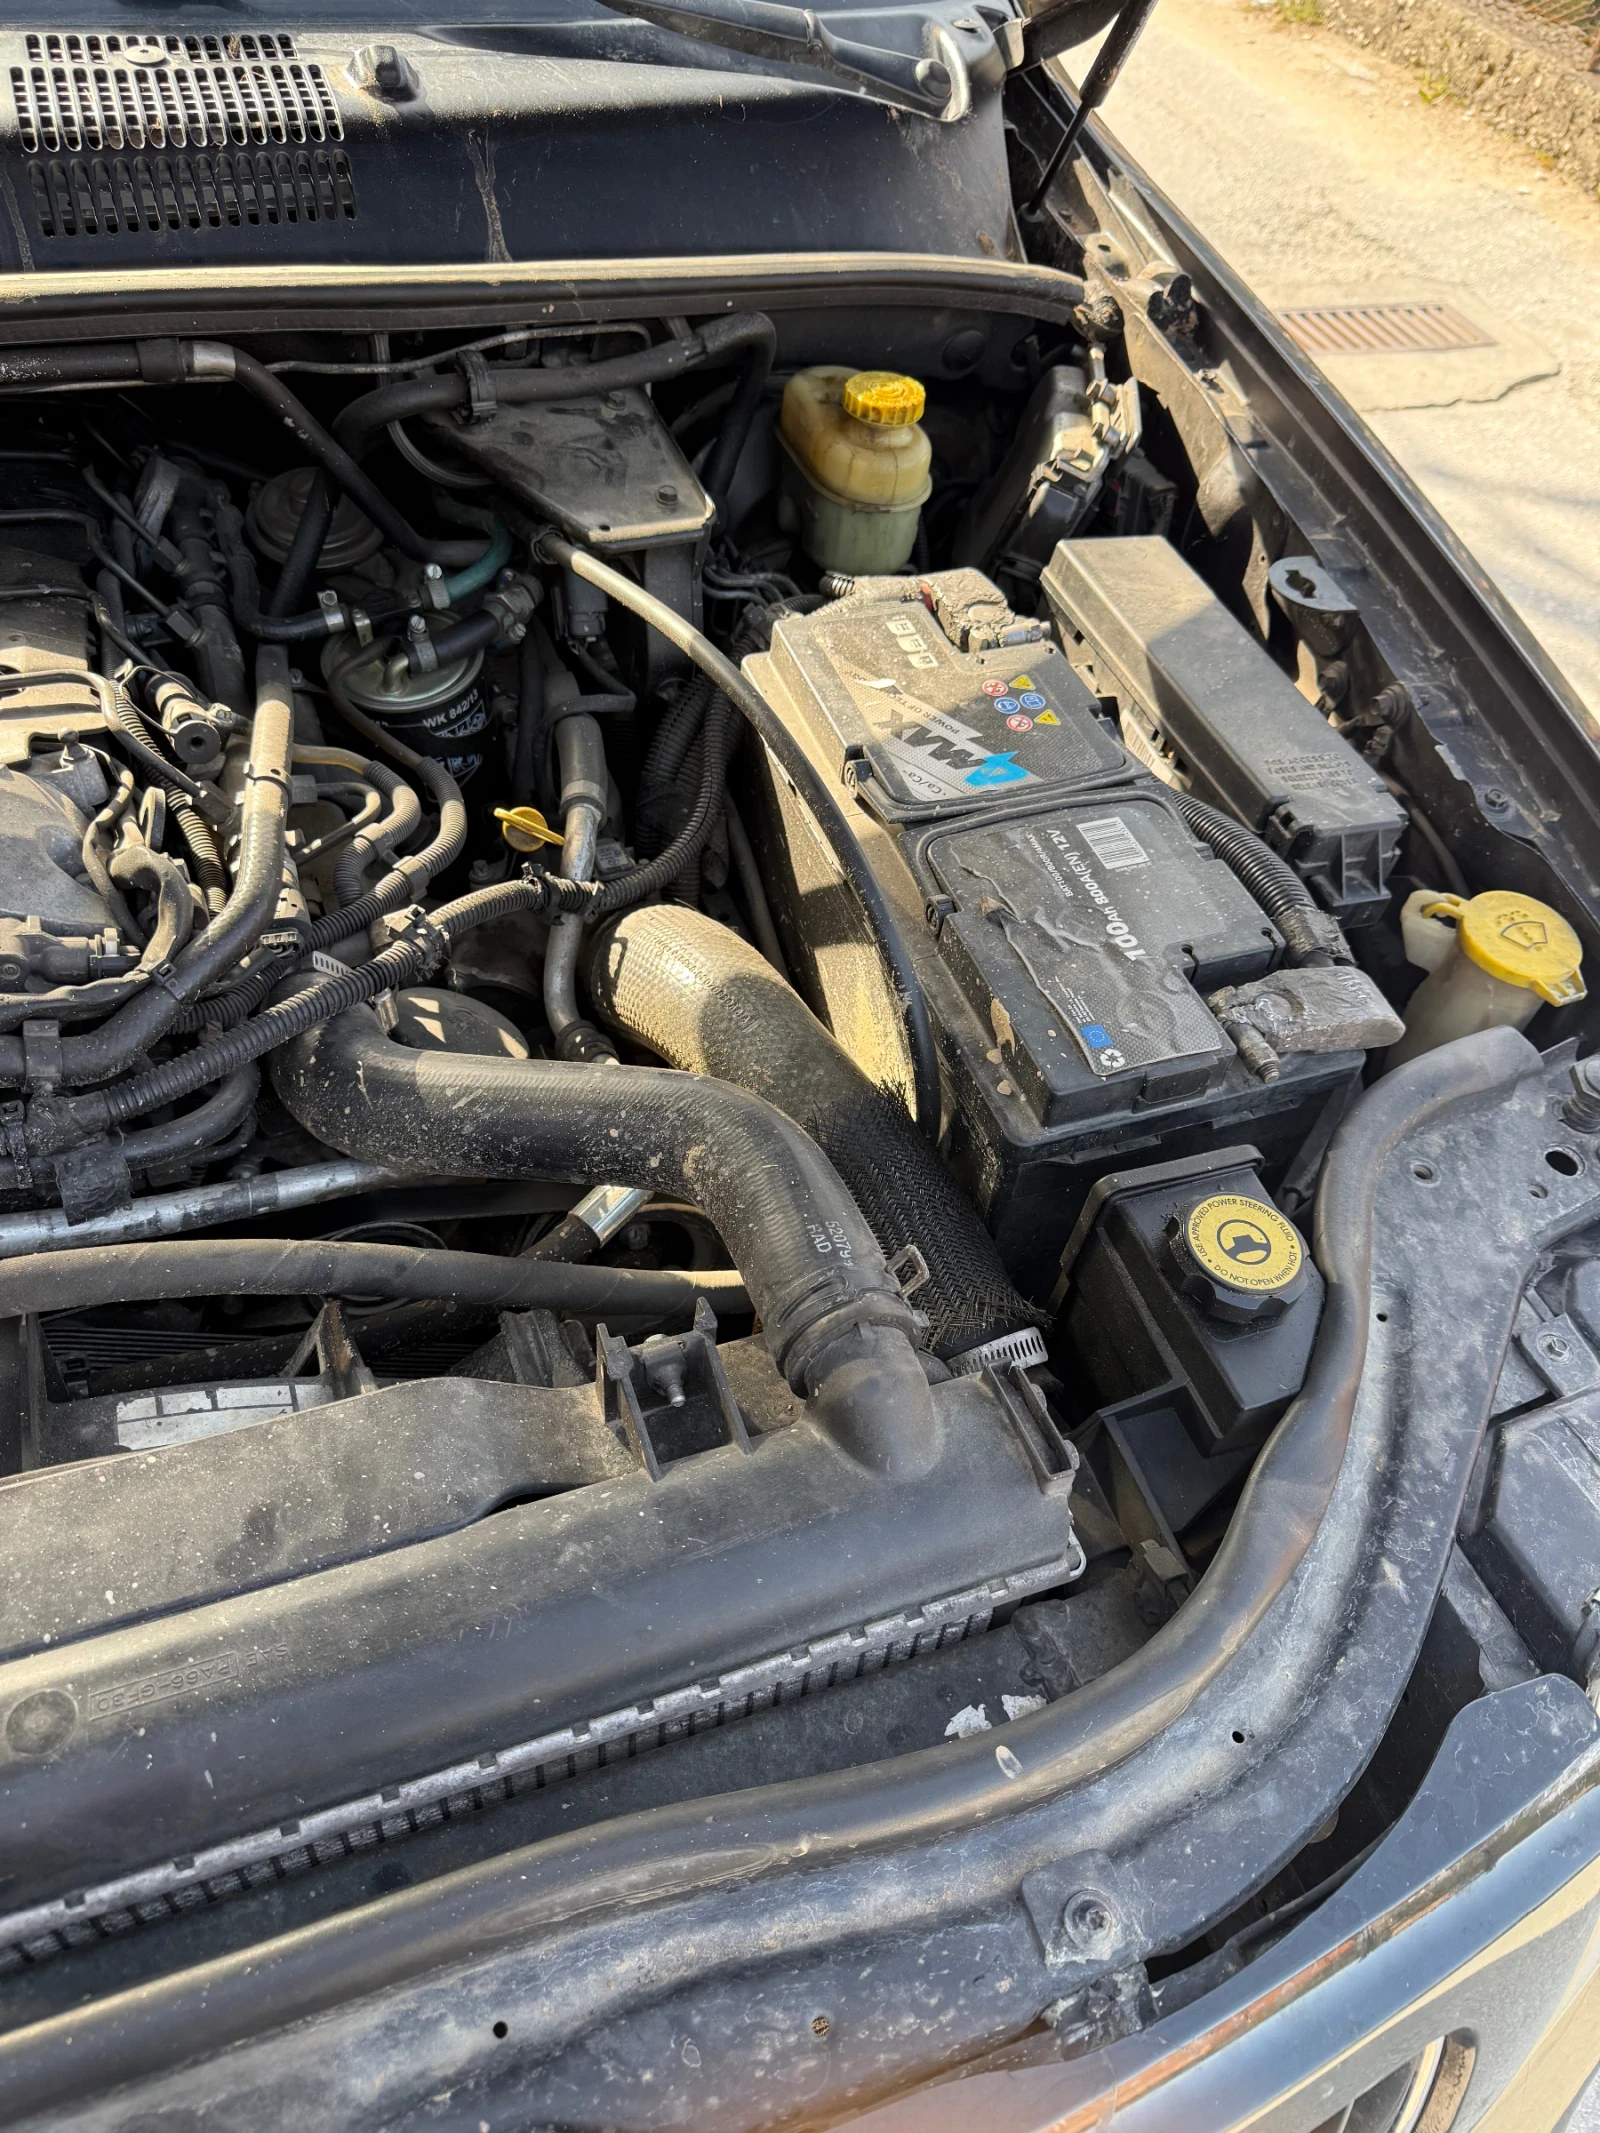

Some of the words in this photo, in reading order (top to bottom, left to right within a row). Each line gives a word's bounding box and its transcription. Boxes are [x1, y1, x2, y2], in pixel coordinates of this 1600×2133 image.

[421, 715, 448, 728] WK
[448, 688, 479, 720] 842/13
[907, 701, 923, 713] OF
[923, 710, 961, 735] POWER
[907, 771, 942, 794] Ca/Ca
[1046, 829, 1071, 851] 12V
[1064, 851, 1109, 905] 800A(EN)
[1103, 906, 1147, 961] 100Ah
[1207, 1198, 1238, 1210] POWER
[1239, 1199, 1279, 1222] STEERING
[1191, 1206, 1210, 1242] APPROVED
[1277, 1221, 1294, 1242] FLUID
[806, 1223, 832, 1252] RAD
[1196, 1242, 1208, 1258] USE
[1213, 1264, 1229, 1277] DO
[1229, 1273, 1249, 1285] NOT
[1249, 1277, 1274, 1286] OPEN
[1272, 1266, 1293, 1282] WHEN
[1287, 1251, 1298, 1267] HOT
[245, 1642, 289, 1668] SAE
[97, 1663, 233, 1711] PA66-GF30
